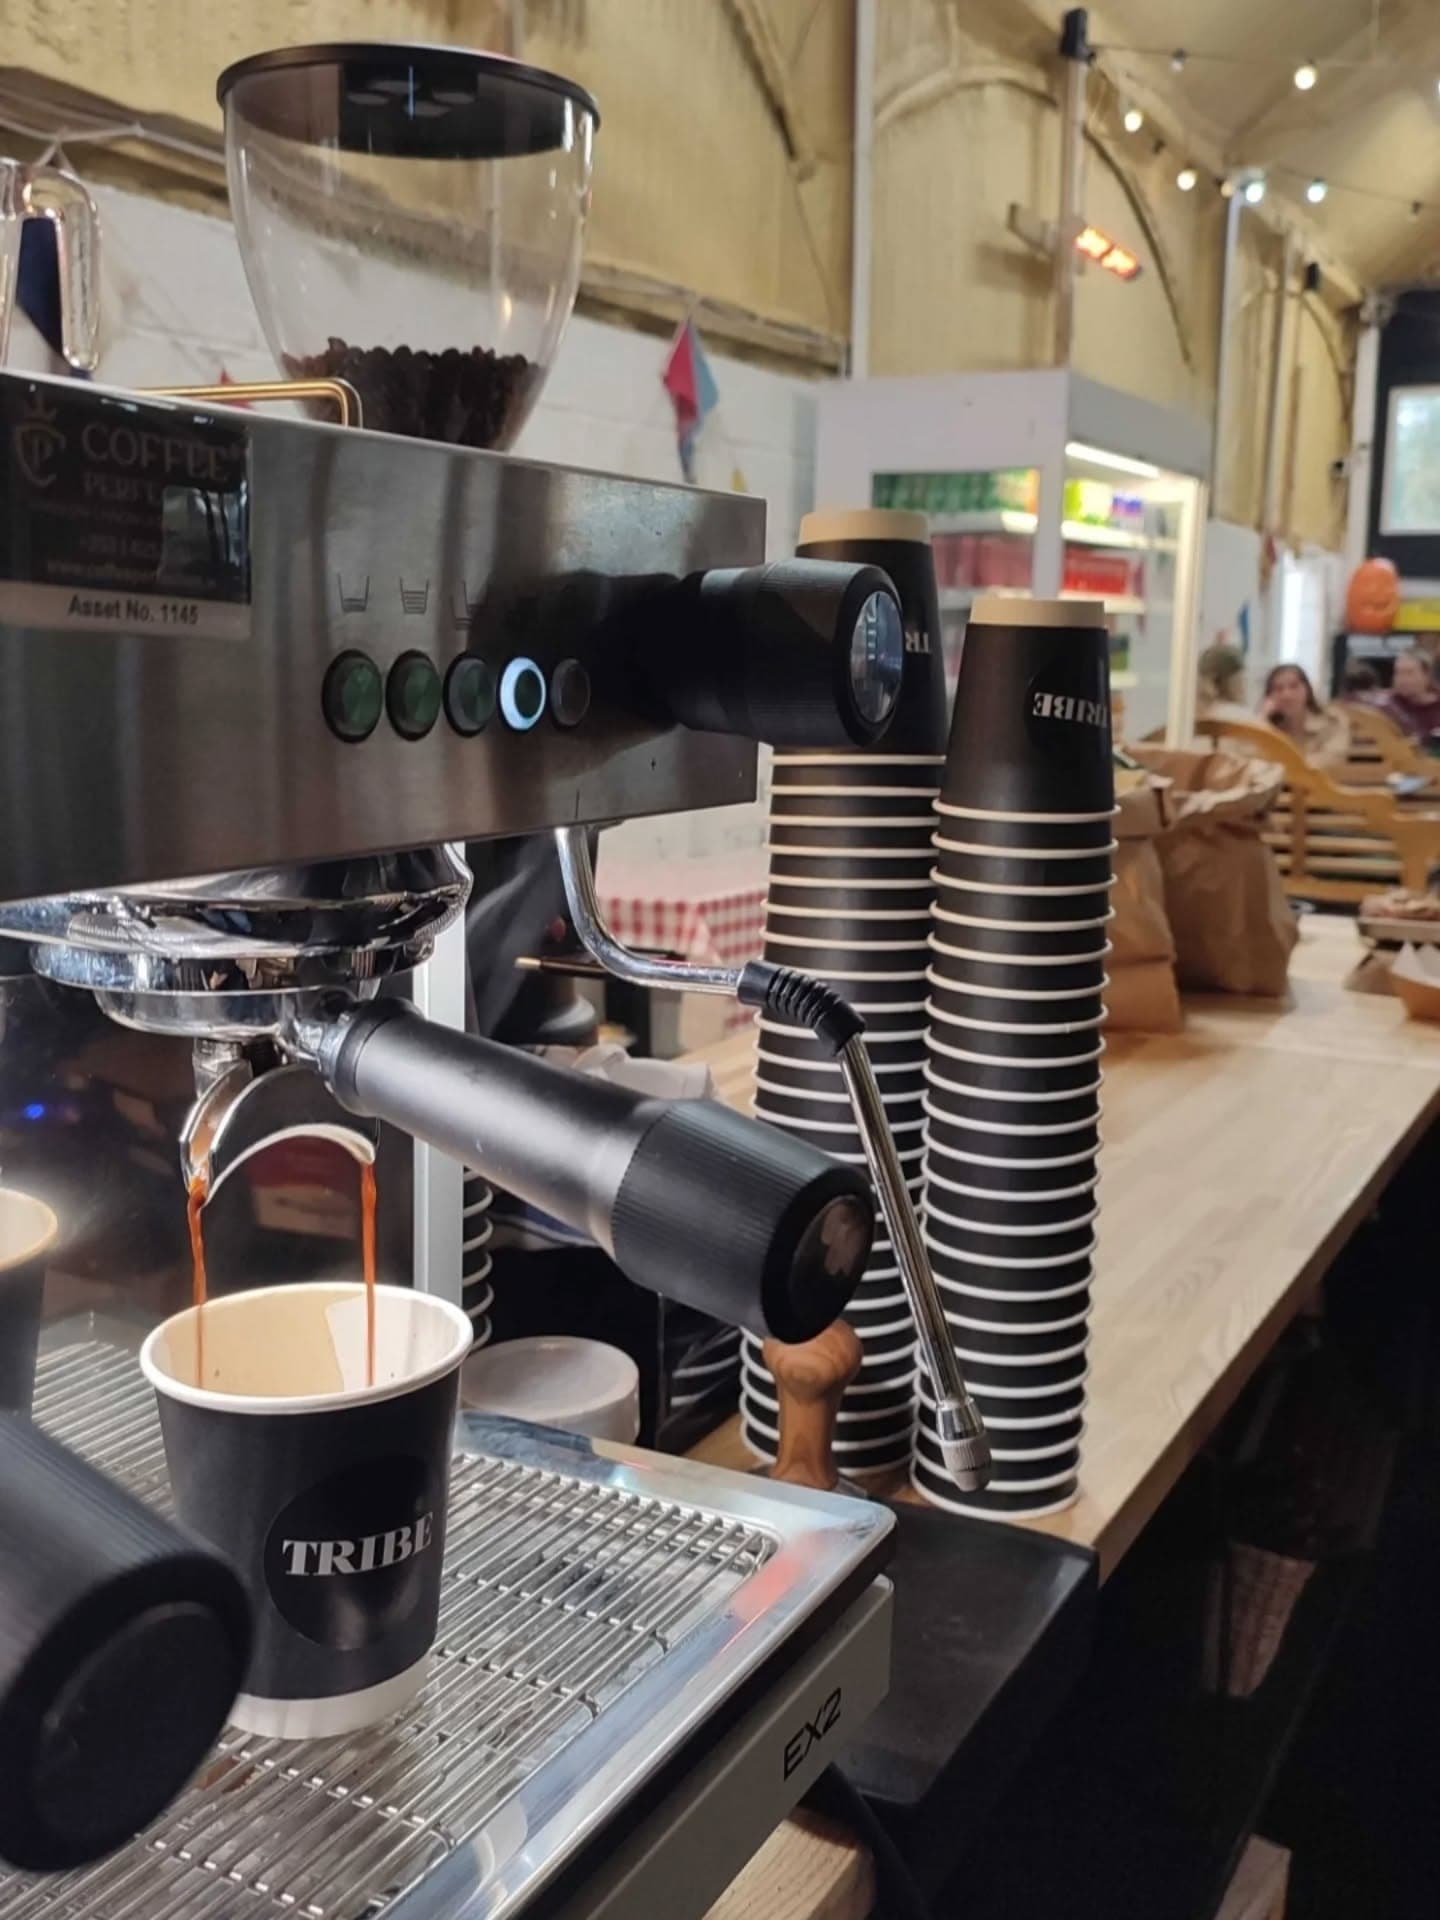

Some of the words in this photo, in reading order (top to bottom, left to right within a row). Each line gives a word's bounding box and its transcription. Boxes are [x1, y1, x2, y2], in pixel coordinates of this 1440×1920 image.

[68, 593, 119, 618] Asset
[126, 599, 153, 622] No.
[160, 603, 198, 625] 1145
[282, 1512, 433, 1576] TRIBE
[784, 1687, 841, 1780] EX2
